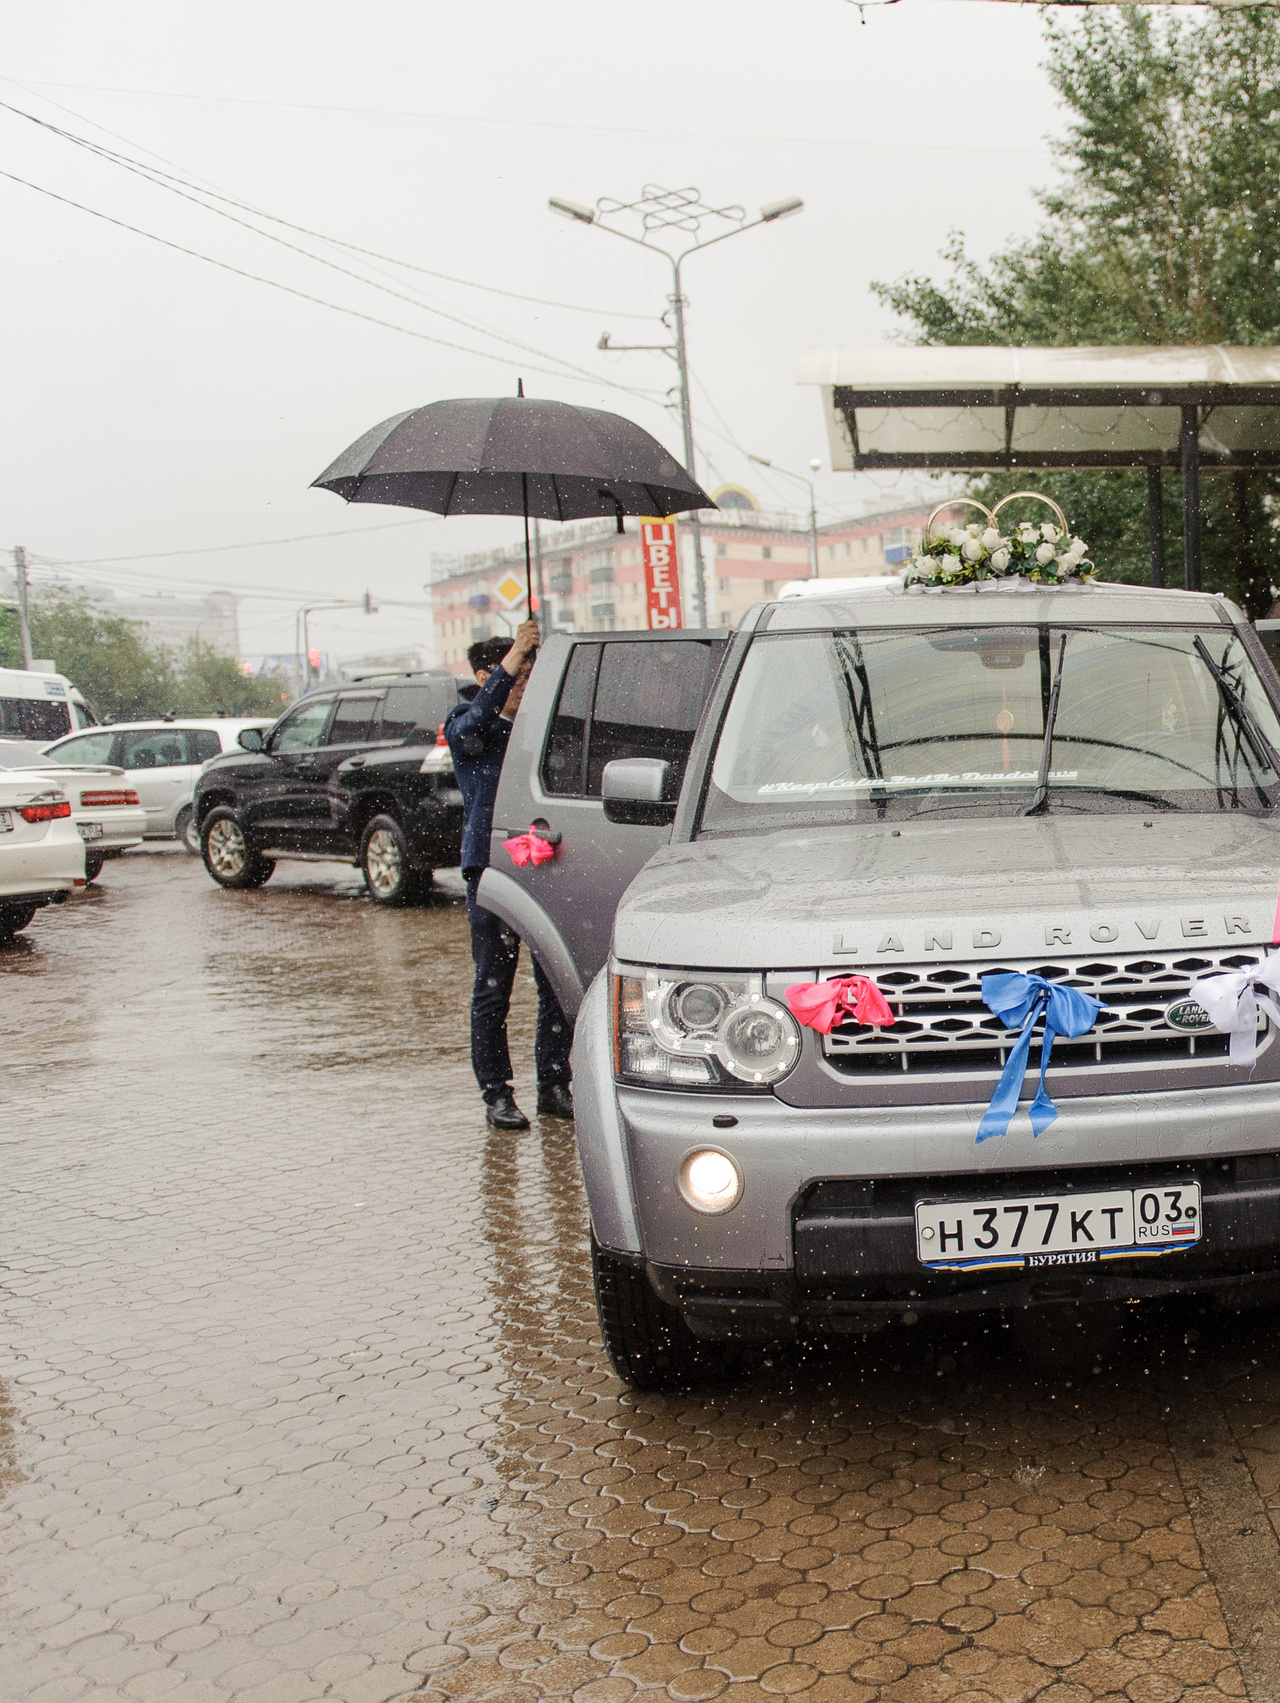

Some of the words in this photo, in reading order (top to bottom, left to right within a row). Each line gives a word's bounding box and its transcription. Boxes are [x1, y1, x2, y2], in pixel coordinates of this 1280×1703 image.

[644, 523, 678, 629] ЦВЕТЫ
[832, 928, 1002, 954] LAND
[1044, 914, 1252, 946] ROVER
[1139, 1191, 1183, 1224] 03
[1138, 1224, 1171, 1239] RUS
[1028, 1251, 1097, 1268] БУРЯТИЯ
